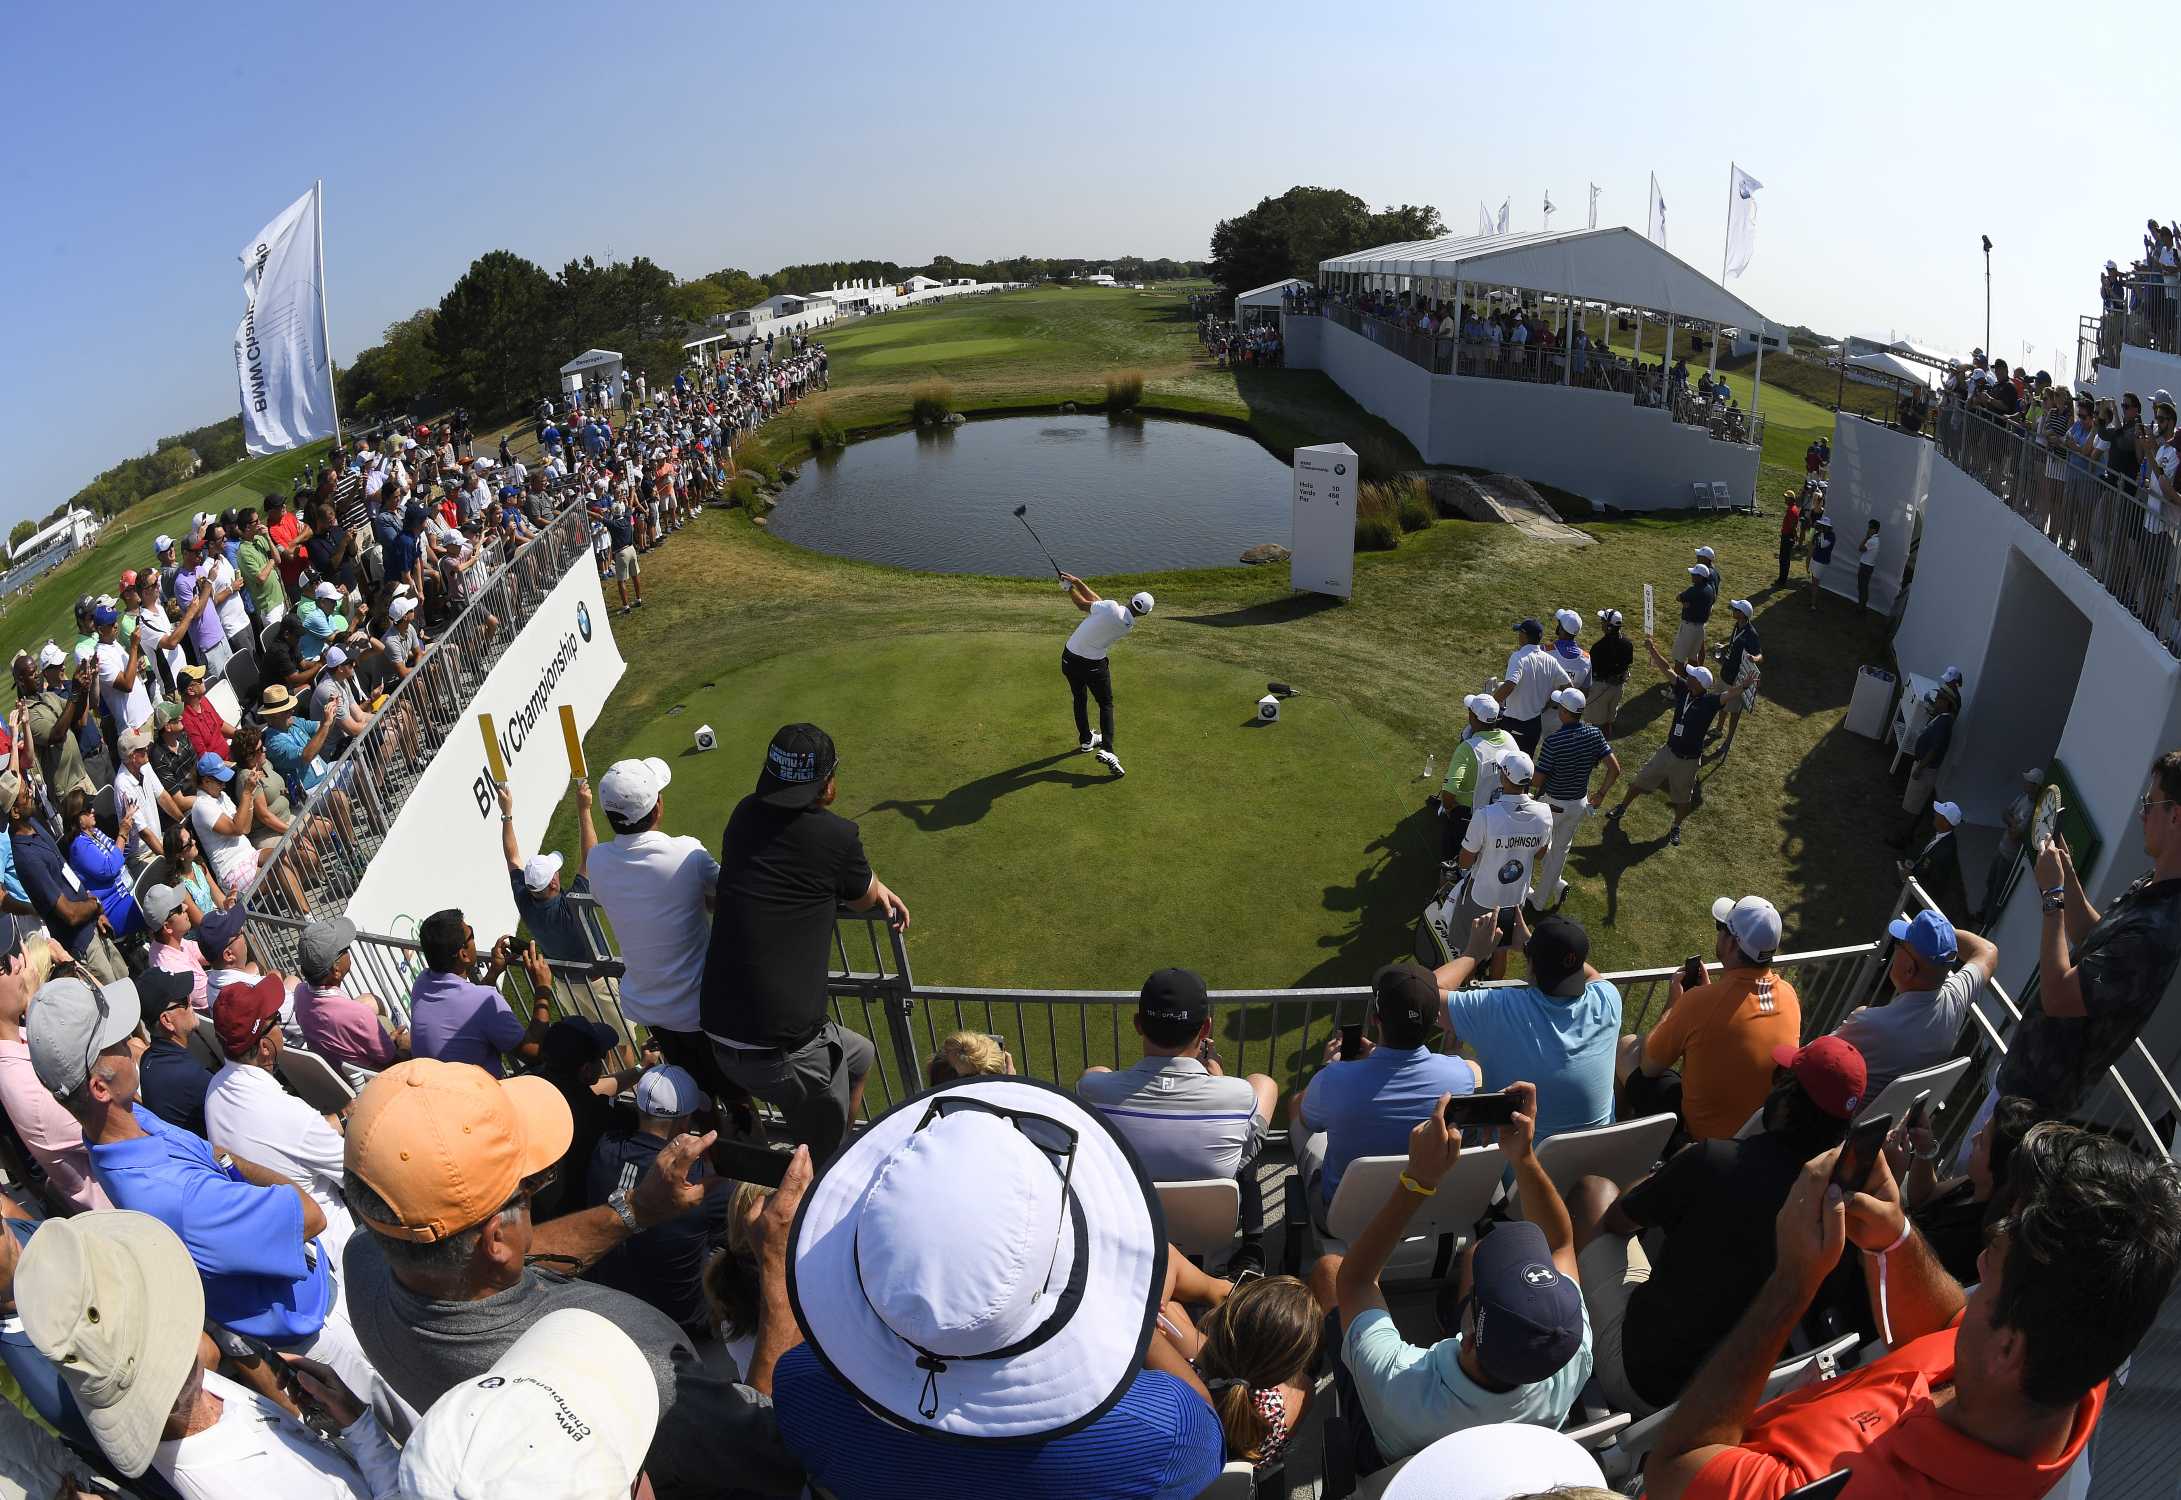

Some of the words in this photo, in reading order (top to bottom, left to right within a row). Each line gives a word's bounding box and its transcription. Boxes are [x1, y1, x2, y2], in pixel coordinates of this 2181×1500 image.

[1299, 481, 1313, 489] Hole
[1299, 489, 1316, 497] Yards
[508, 632, 578, 753] Championship
[1496, 839, 1504, 848] D.
[1505, 837, 1541, 849] JOHNSON
[512, 1376, 592, 1436] Championship
[555, 1411, 584, 1442] BMW
